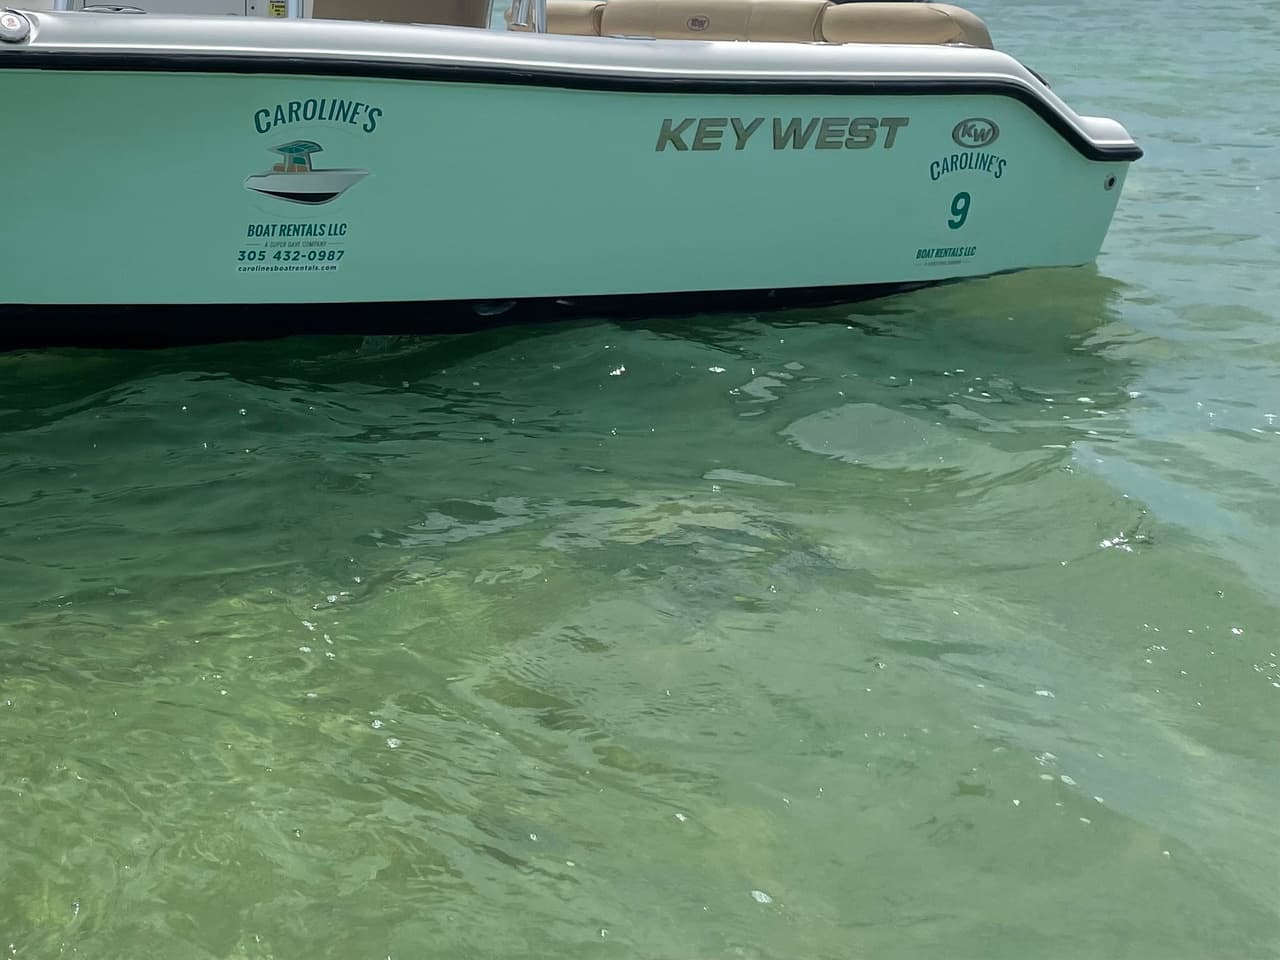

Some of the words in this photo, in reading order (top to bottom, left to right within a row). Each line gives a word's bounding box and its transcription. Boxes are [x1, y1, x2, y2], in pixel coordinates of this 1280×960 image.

[254, 98, 383, 133] CAROLINE'S
[655, 117, 765, 151] KEY
[772, 117, 910, 150] WEST
[961, 123, 992, 142] KW
[930, 152, 1007, 181] CAROLINE'S
[948, 192, 971, 229] 9
[247, 224, 278, 237] BOAT
[279, 223, 326, 237] RENTALS
[328, 223, 347, 236] LLC
[238, 250, 266, 261] 305
[273, 250, 345, 261] 432-0987
[916, 248, 936, 259] BOAT
[935, 247, 964, 258] RENTALS
